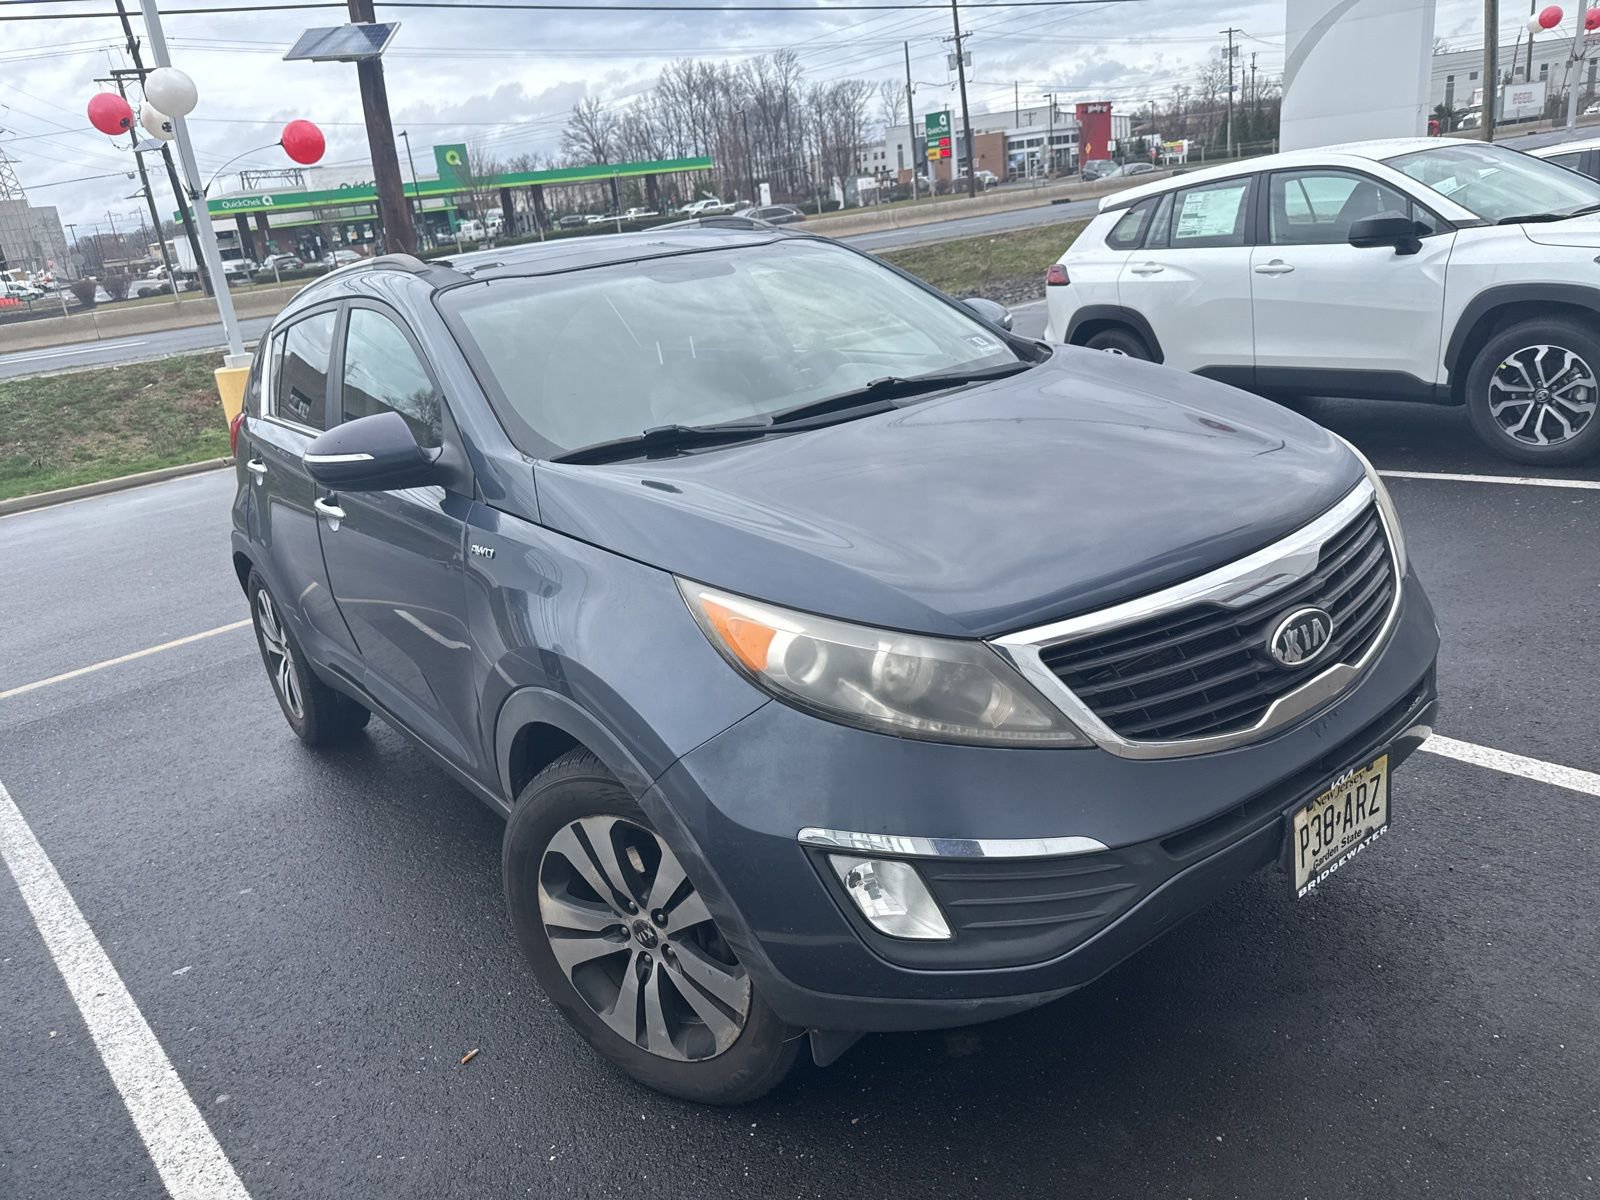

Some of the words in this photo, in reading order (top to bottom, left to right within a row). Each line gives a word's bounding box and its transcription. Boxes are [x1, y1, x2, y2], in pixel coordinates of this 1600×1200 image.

[222, 198, 262, 209] QuickChek
[1282, 617, 1327, 660] KIA
[1312, 792, 1336, 811] New
[1335, 771, 1365, 798] Jersey
[1330, 768, 1354, 790] KIA
[1298, 824, 1389, 898] BRIDGEWATER
[1313, 846, 1339, 869] Garden
[1341, 828, 1362, 848] State
